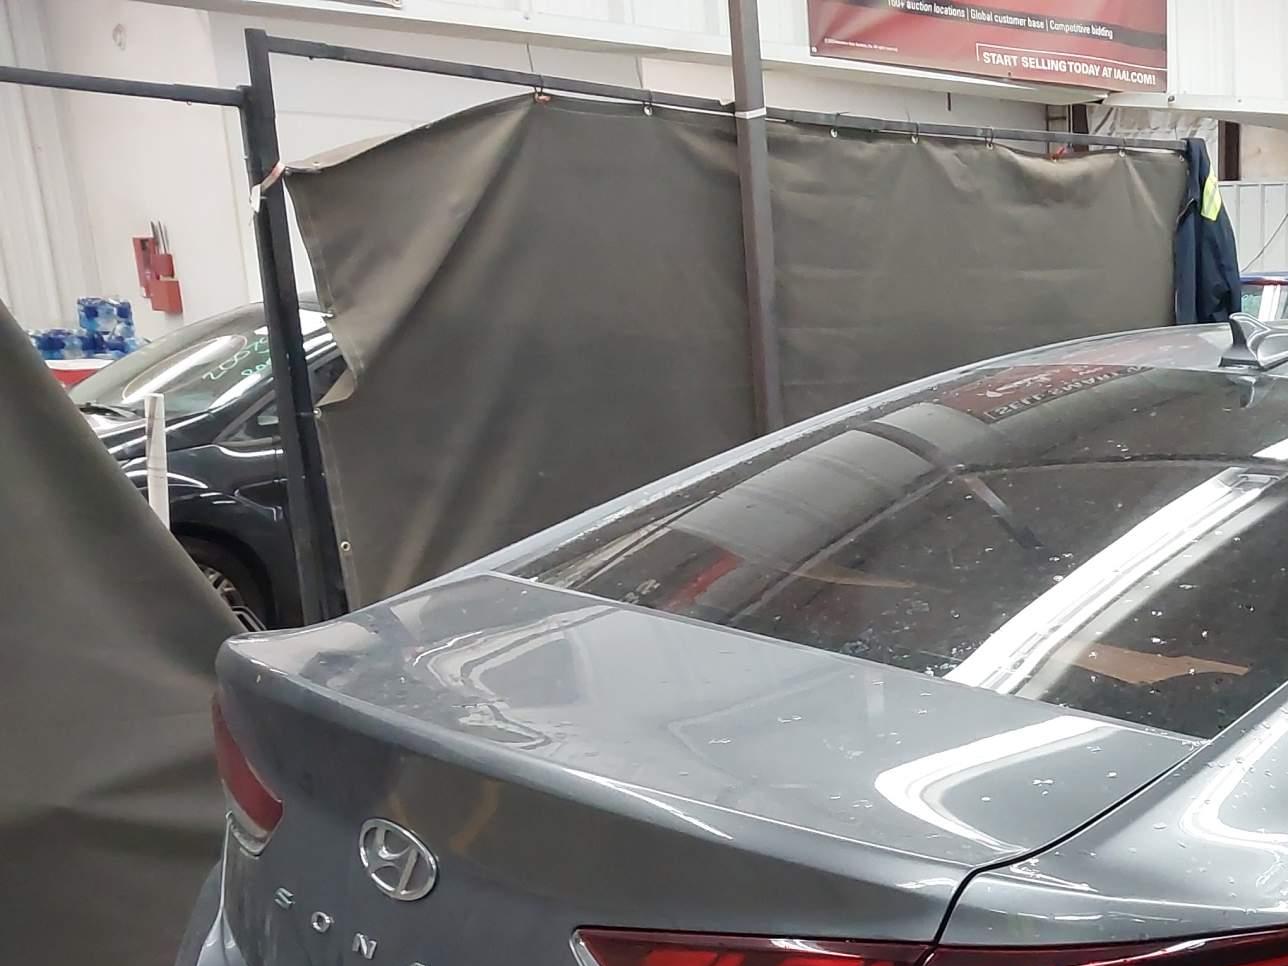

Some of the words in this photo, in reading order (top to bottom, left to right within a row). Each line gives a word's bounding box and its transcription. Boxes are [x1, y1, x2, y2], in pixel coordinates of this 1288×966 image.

[906, 0, 933, 13] auction
[933, 3, 966, 18] locations
[970, 8, 993, 22] Global
[993, 14, 1027, 27] customer
[1027, 16, 1045, 29] base
[1049, 19, 1091, 34] Competitive
[1091, 24, 1114, 40] bidding
[983, 51, 1018, 67] START
[1021, 57, 1067, 73] SELLING
[1069, 62, 1101, 77] TODAY
[1101, 66, 1114, 78] AT
